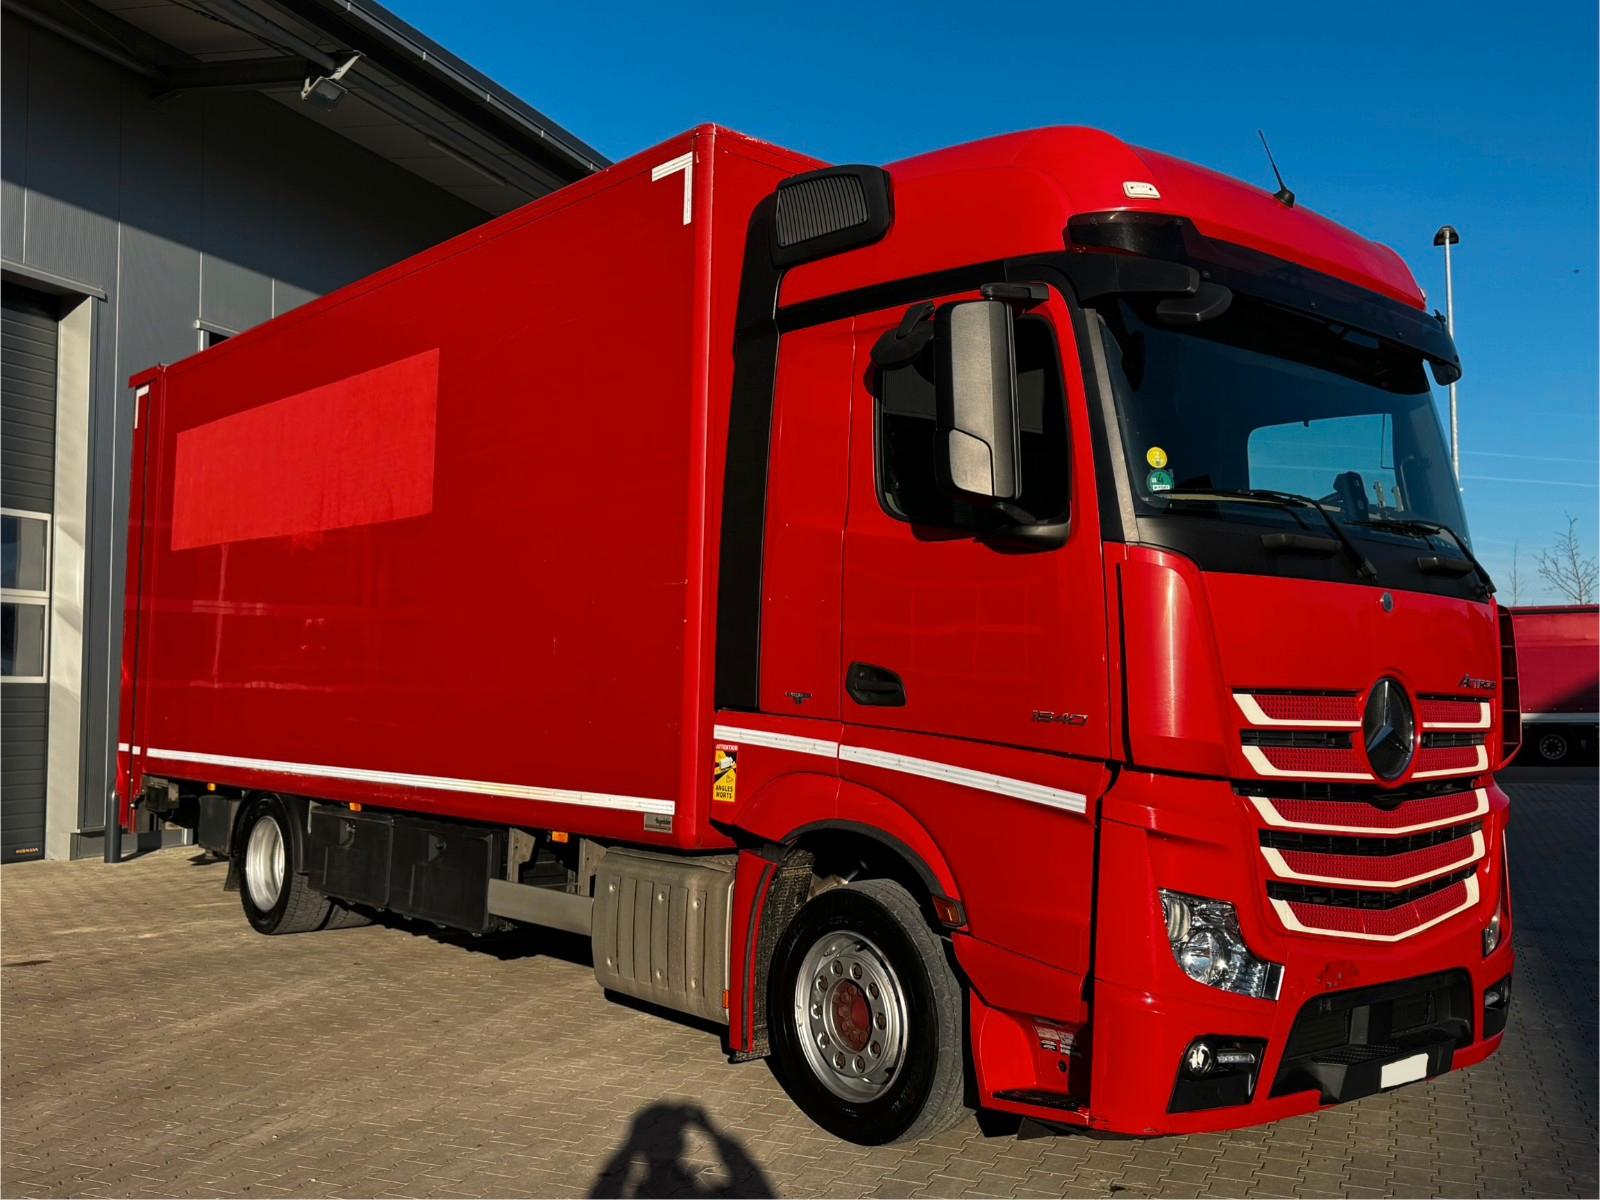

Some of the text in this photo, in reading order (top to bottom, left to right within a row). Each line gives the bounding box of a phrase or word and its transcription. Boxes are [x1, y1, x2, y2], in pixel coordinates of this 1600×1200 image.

[716, 743, 738, 751] ATTENTION
[715, 784, 733, 792] ANGLES
[715, 791, 732, 799] MORTS
